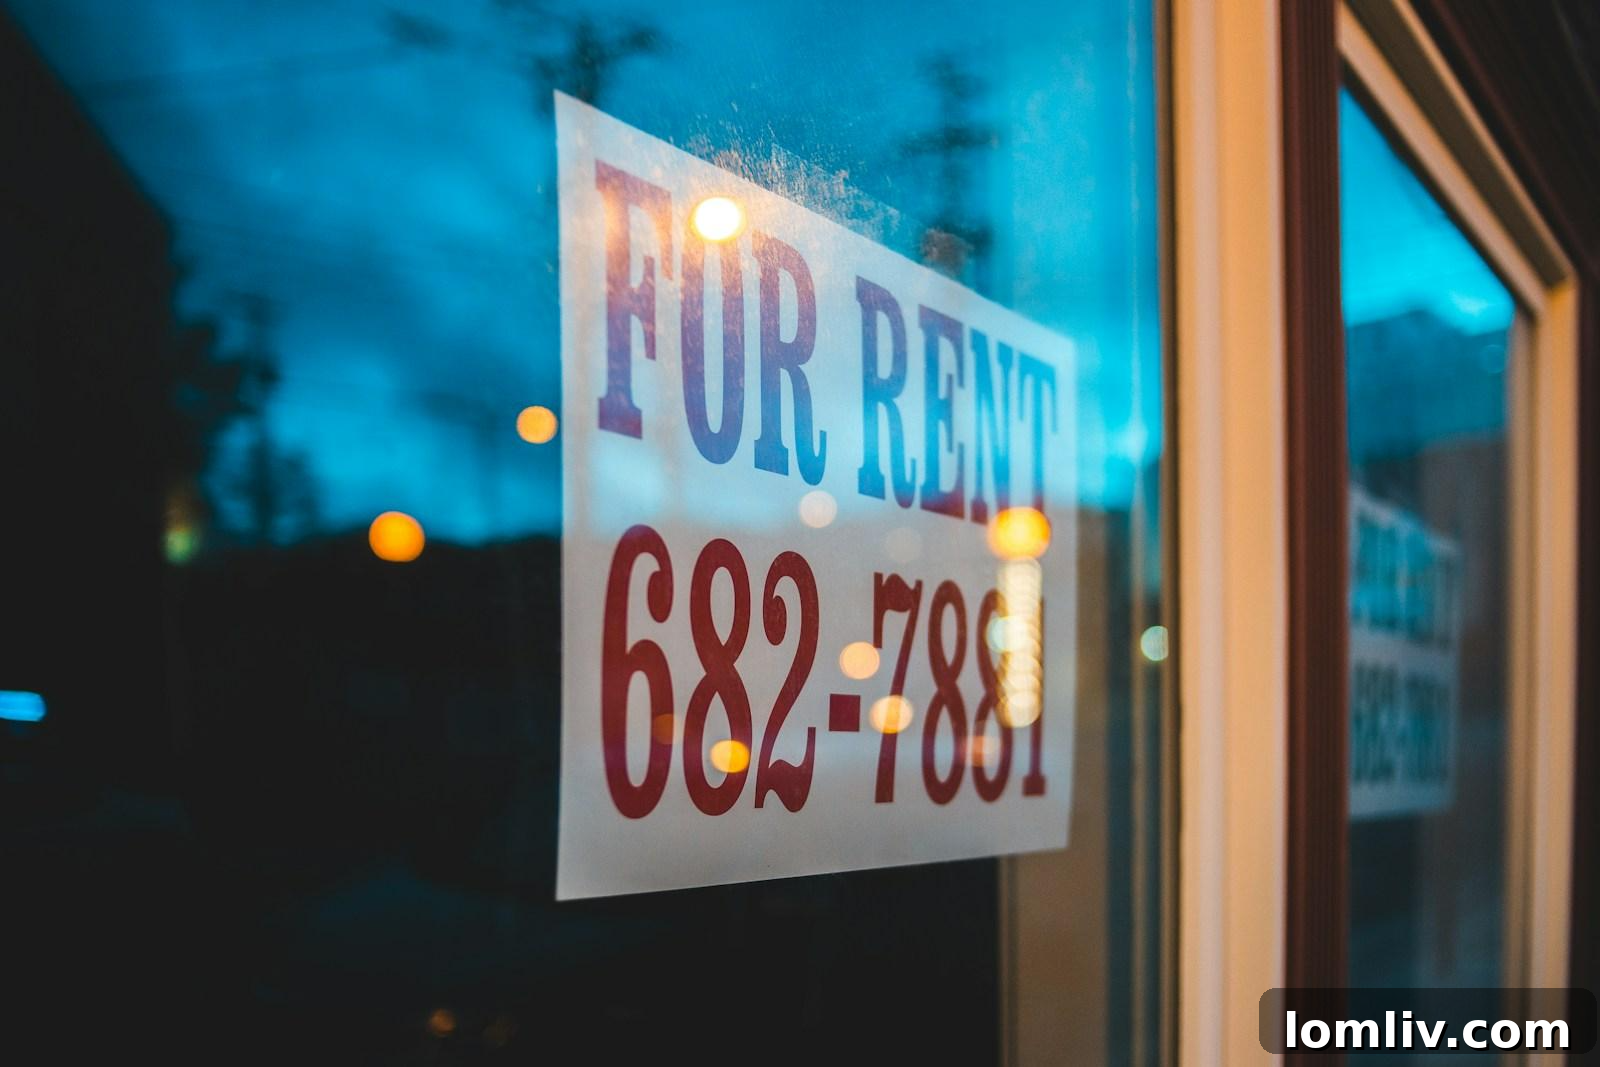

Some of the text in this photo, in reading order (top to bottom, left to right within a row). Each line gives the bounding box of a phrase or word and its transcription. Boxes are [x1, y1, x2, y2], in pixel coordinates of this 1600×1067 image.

[595, 159, 1059, 526] FOR RENT
[600, 524, 1047, 820] 682-7881
